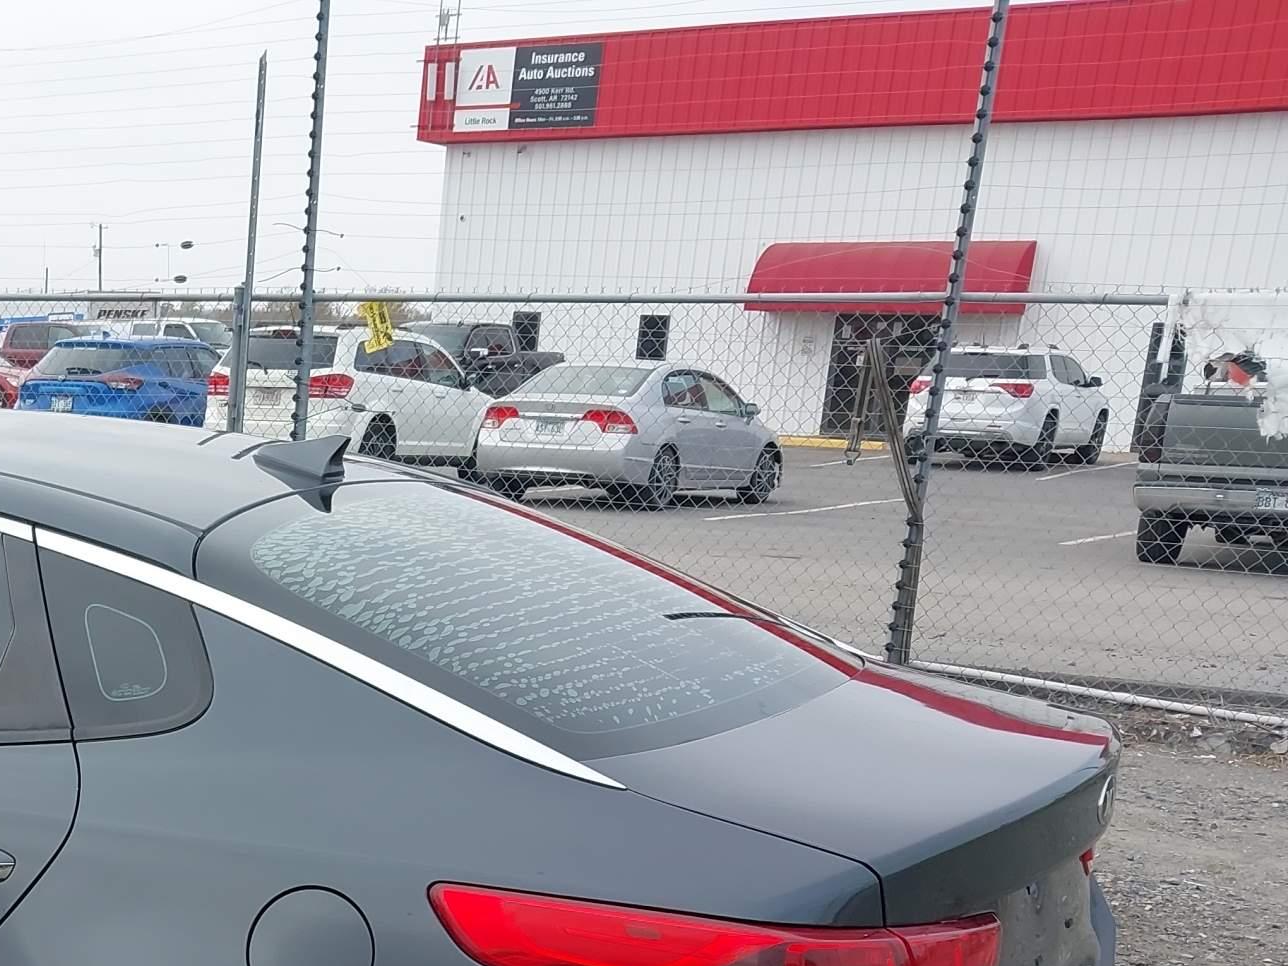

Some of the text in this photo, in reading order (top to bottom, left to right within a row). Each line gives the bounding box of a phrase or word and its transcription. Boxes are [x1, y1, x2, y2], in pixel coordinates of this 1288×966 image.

[531, 51, 585, 64] Insurance
[518, 65, 595, 80] Auto Auctions
[481, 117, 496, 125] Rock
[96, 309, 149, 319] PENSKE
